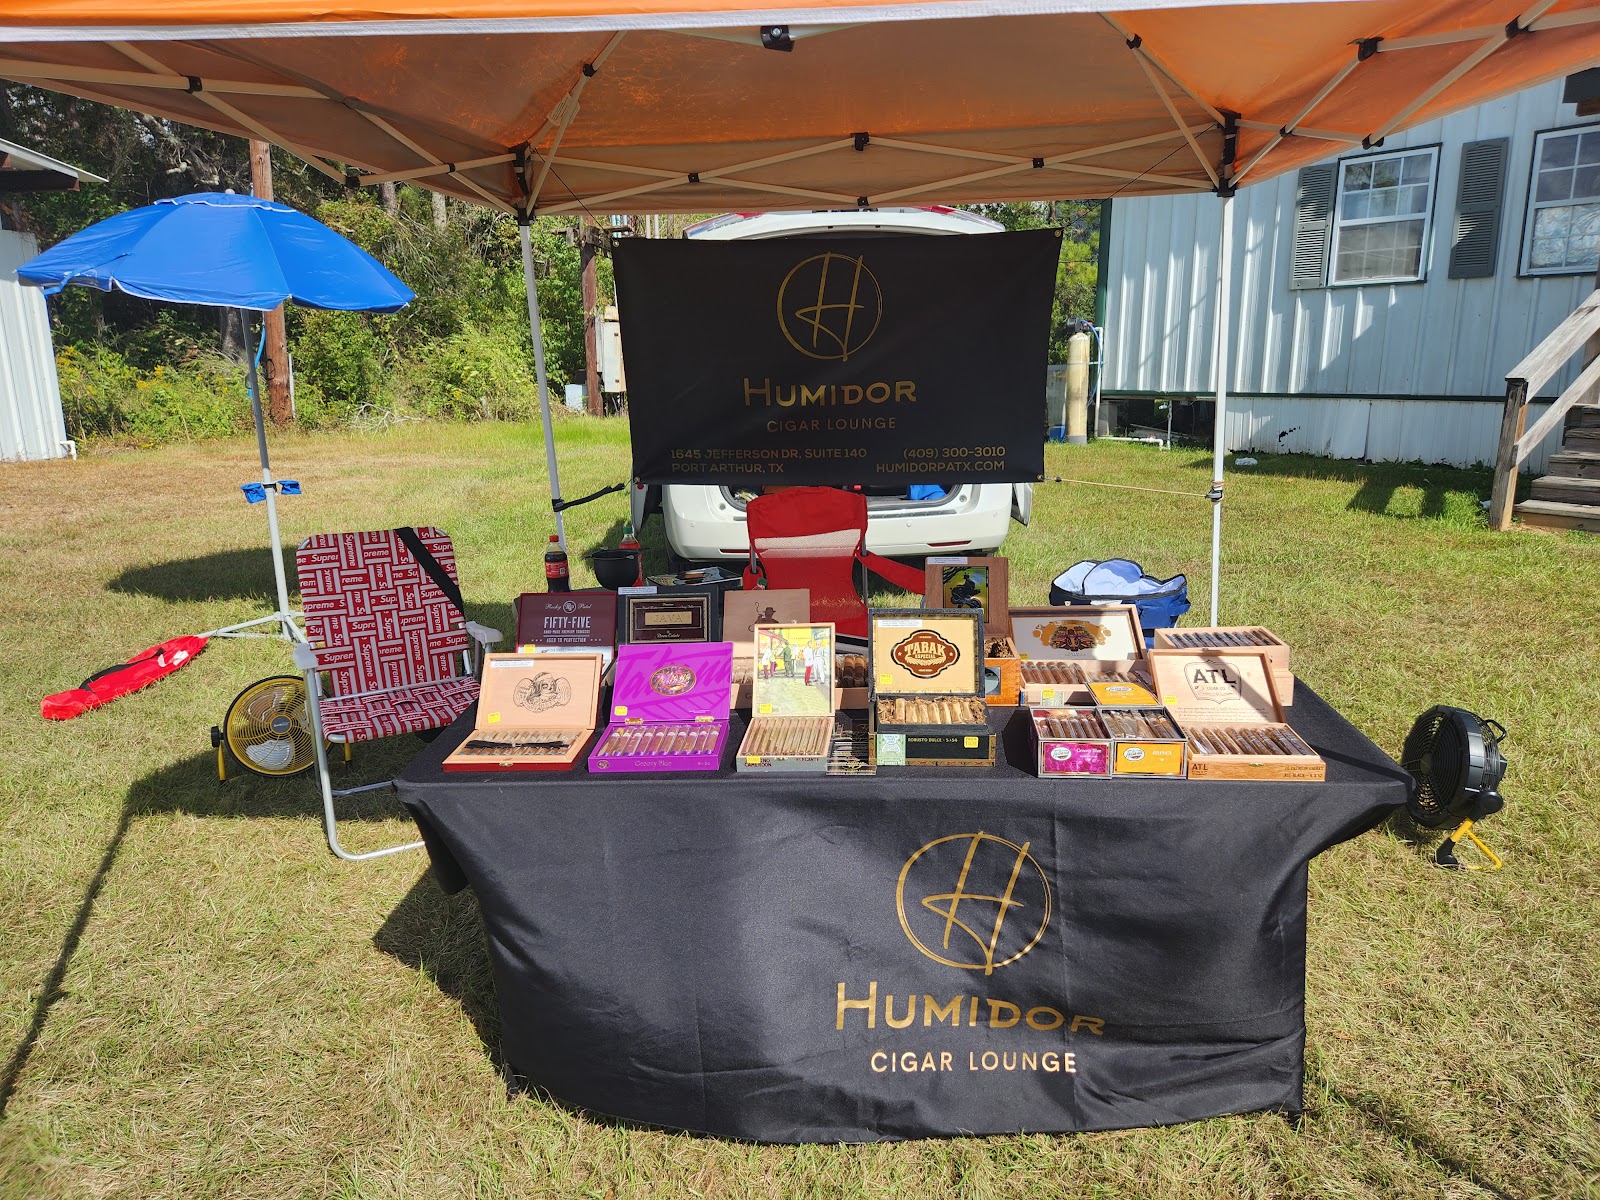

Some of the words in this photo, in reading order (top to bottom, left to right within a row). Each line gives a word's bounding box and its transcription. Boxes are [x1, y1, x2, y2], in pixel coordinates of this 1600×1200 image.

[743, 377, 917, 407] HUMIDOR
[767, 420, 820, 432] CIGAR
[828, 417, 896, 430] LOUNGE
[671, 450, 701, 459] 1645
[705, 449, 778, 459] JEFFERSON
[781, 449, 802, 460] DR,
[805, 449, 842, 459] SUITE
[844, 448, 867, 458] 140
[903, 448, 939, 459] (409)
[942, 446, 1006, 458] 300-3010
[672, 463, 706, 473] PORT
[709, 463, 765, 474] ARTHUR,
[768, 463, 784, 473] TX
[876, 461, 1005, 473] HUMIDORPATX.COM
[544, 616, 591, 628] FIFTY-FIVE
[654, 614, 683, 622] JAVA
[904, 641, 946, 656] TABAK
[361, 643, 373, 677] Supreme
[1193, 668, 1237, 684] ATL
[1192, 763, 1208, 771] ATL
[836, 981, 1105, 1035] HUMIDOR
[870, 1051, 953, 1073] CIGAR
[969, 1051, 1077, 1073] LOUNGE
